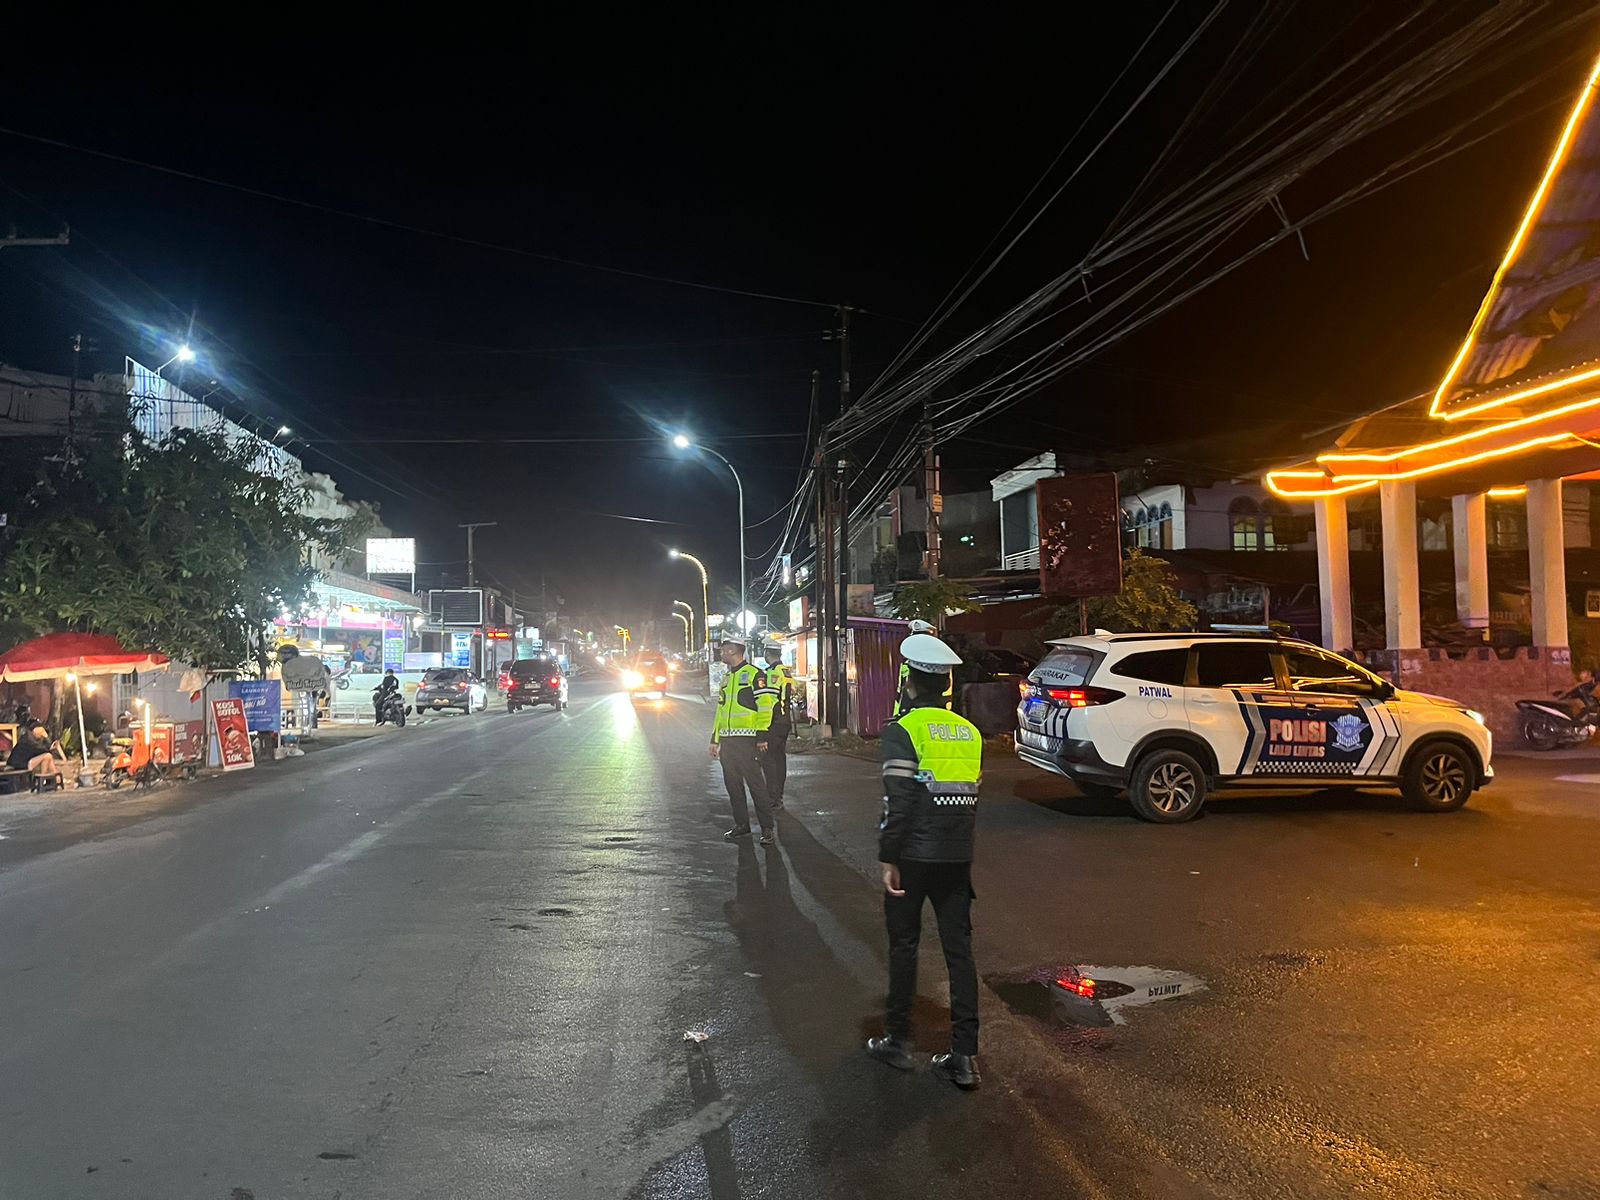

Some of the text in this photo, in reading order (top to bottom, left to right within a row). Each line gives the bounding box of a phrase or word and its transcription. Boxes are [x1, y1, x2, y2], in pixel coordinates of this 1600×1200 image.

[1138, 686, 1172, 698] PATWAL
[217, 707, 241, 717] BOTOL
[927, 723, 974, 742] POLISI
[1269, 718, 1327, 743] POLISI
[226, 753, 243, 763] 10K
